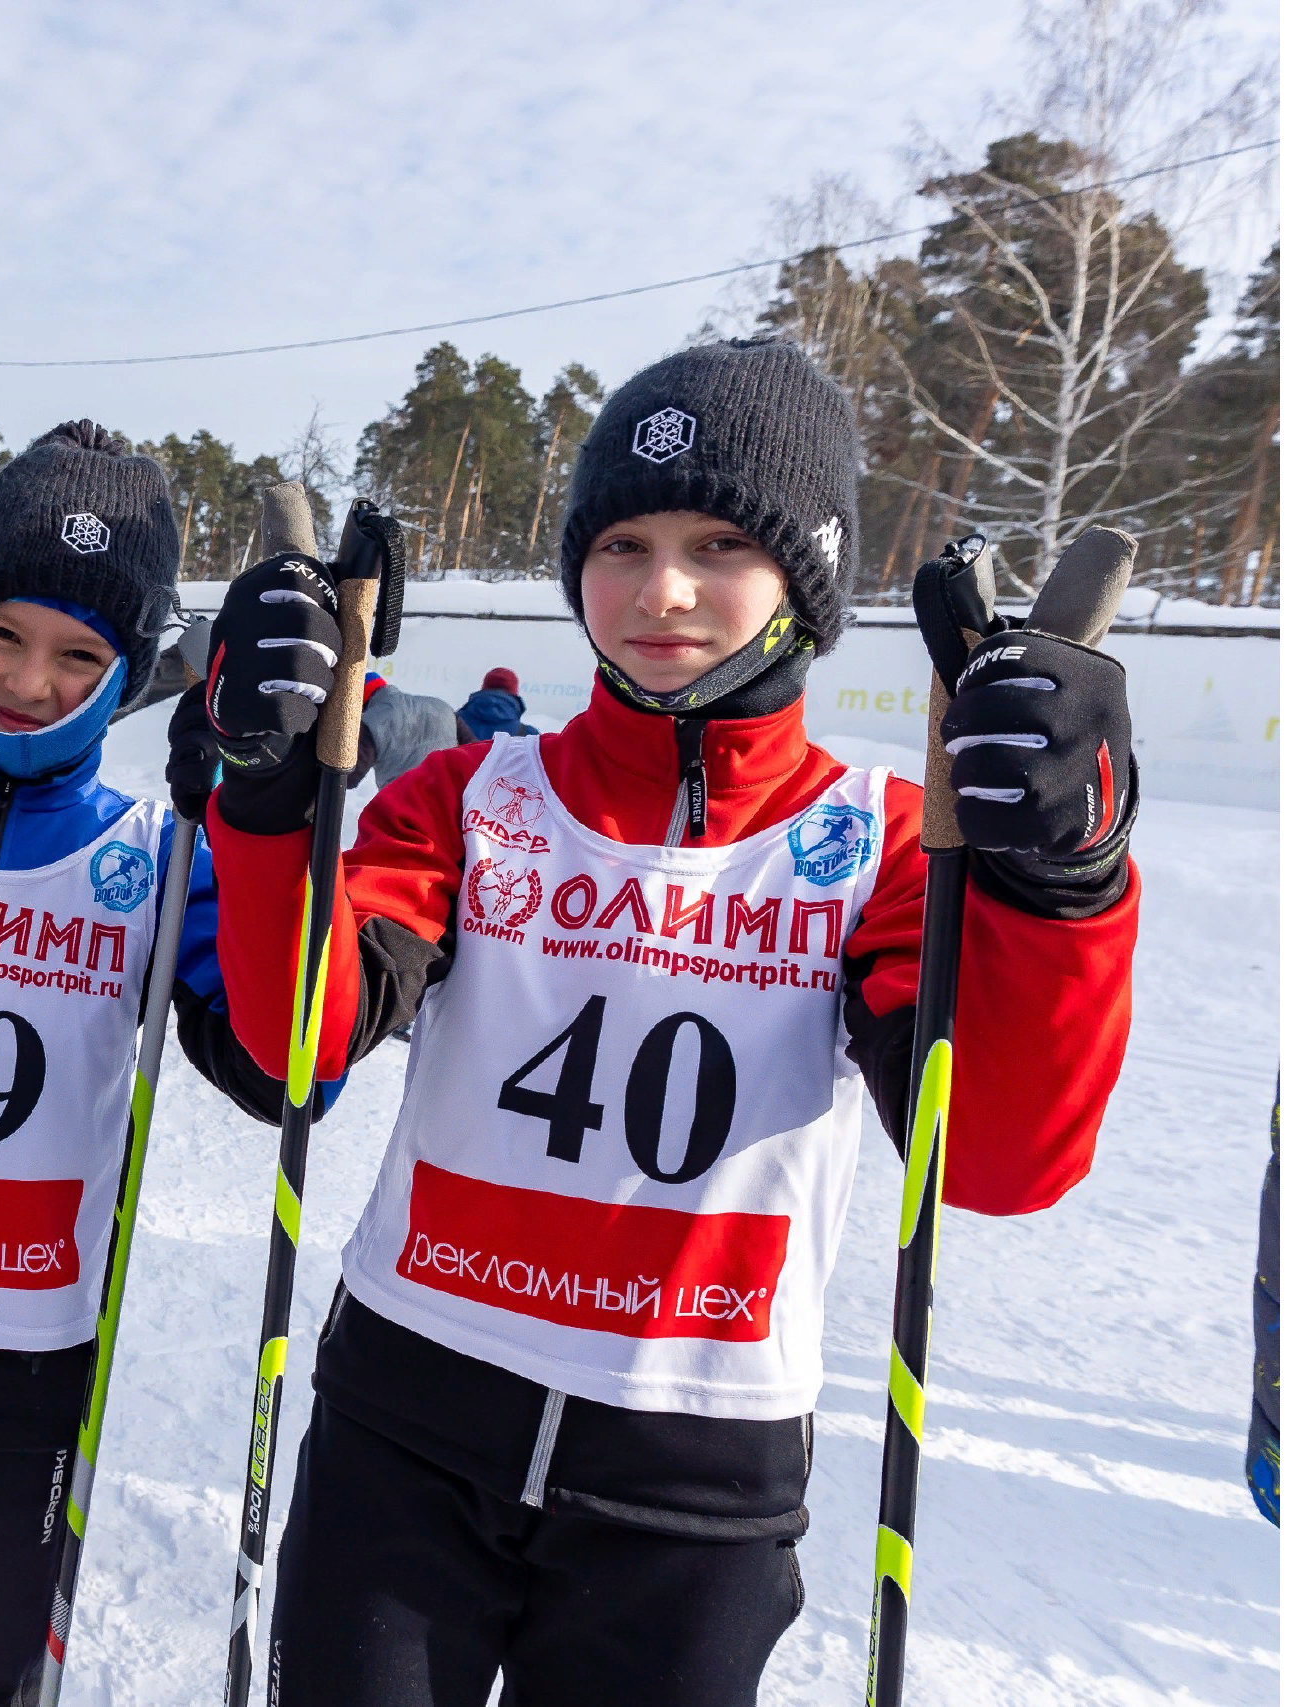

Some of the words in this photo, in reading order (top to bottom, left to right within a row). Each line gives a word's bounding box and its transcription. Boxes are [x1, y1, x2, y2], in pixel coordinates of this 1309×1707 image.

[280, 561, 317, 579] SKI
[969, 646, 1028, 676] TIME
[692, 781, 702, 824] VITZHEN
[1084, 784, 1095, 839] THERMO
[463, 918, 525, 946] ОЛИМП
[551, 874, 844, 959] ОЛИМП
[542, 935, 837, 993] www.olimpsportpit.ru
[498, 995, 736, 1184] 40
[407, 1230, 661, 1318] рекламный
[42, 1449, 67, 1544] NORDSKI
[249, 1486, 263, 1536] 100%
[271, 1639, 284, 1707] VITZ
